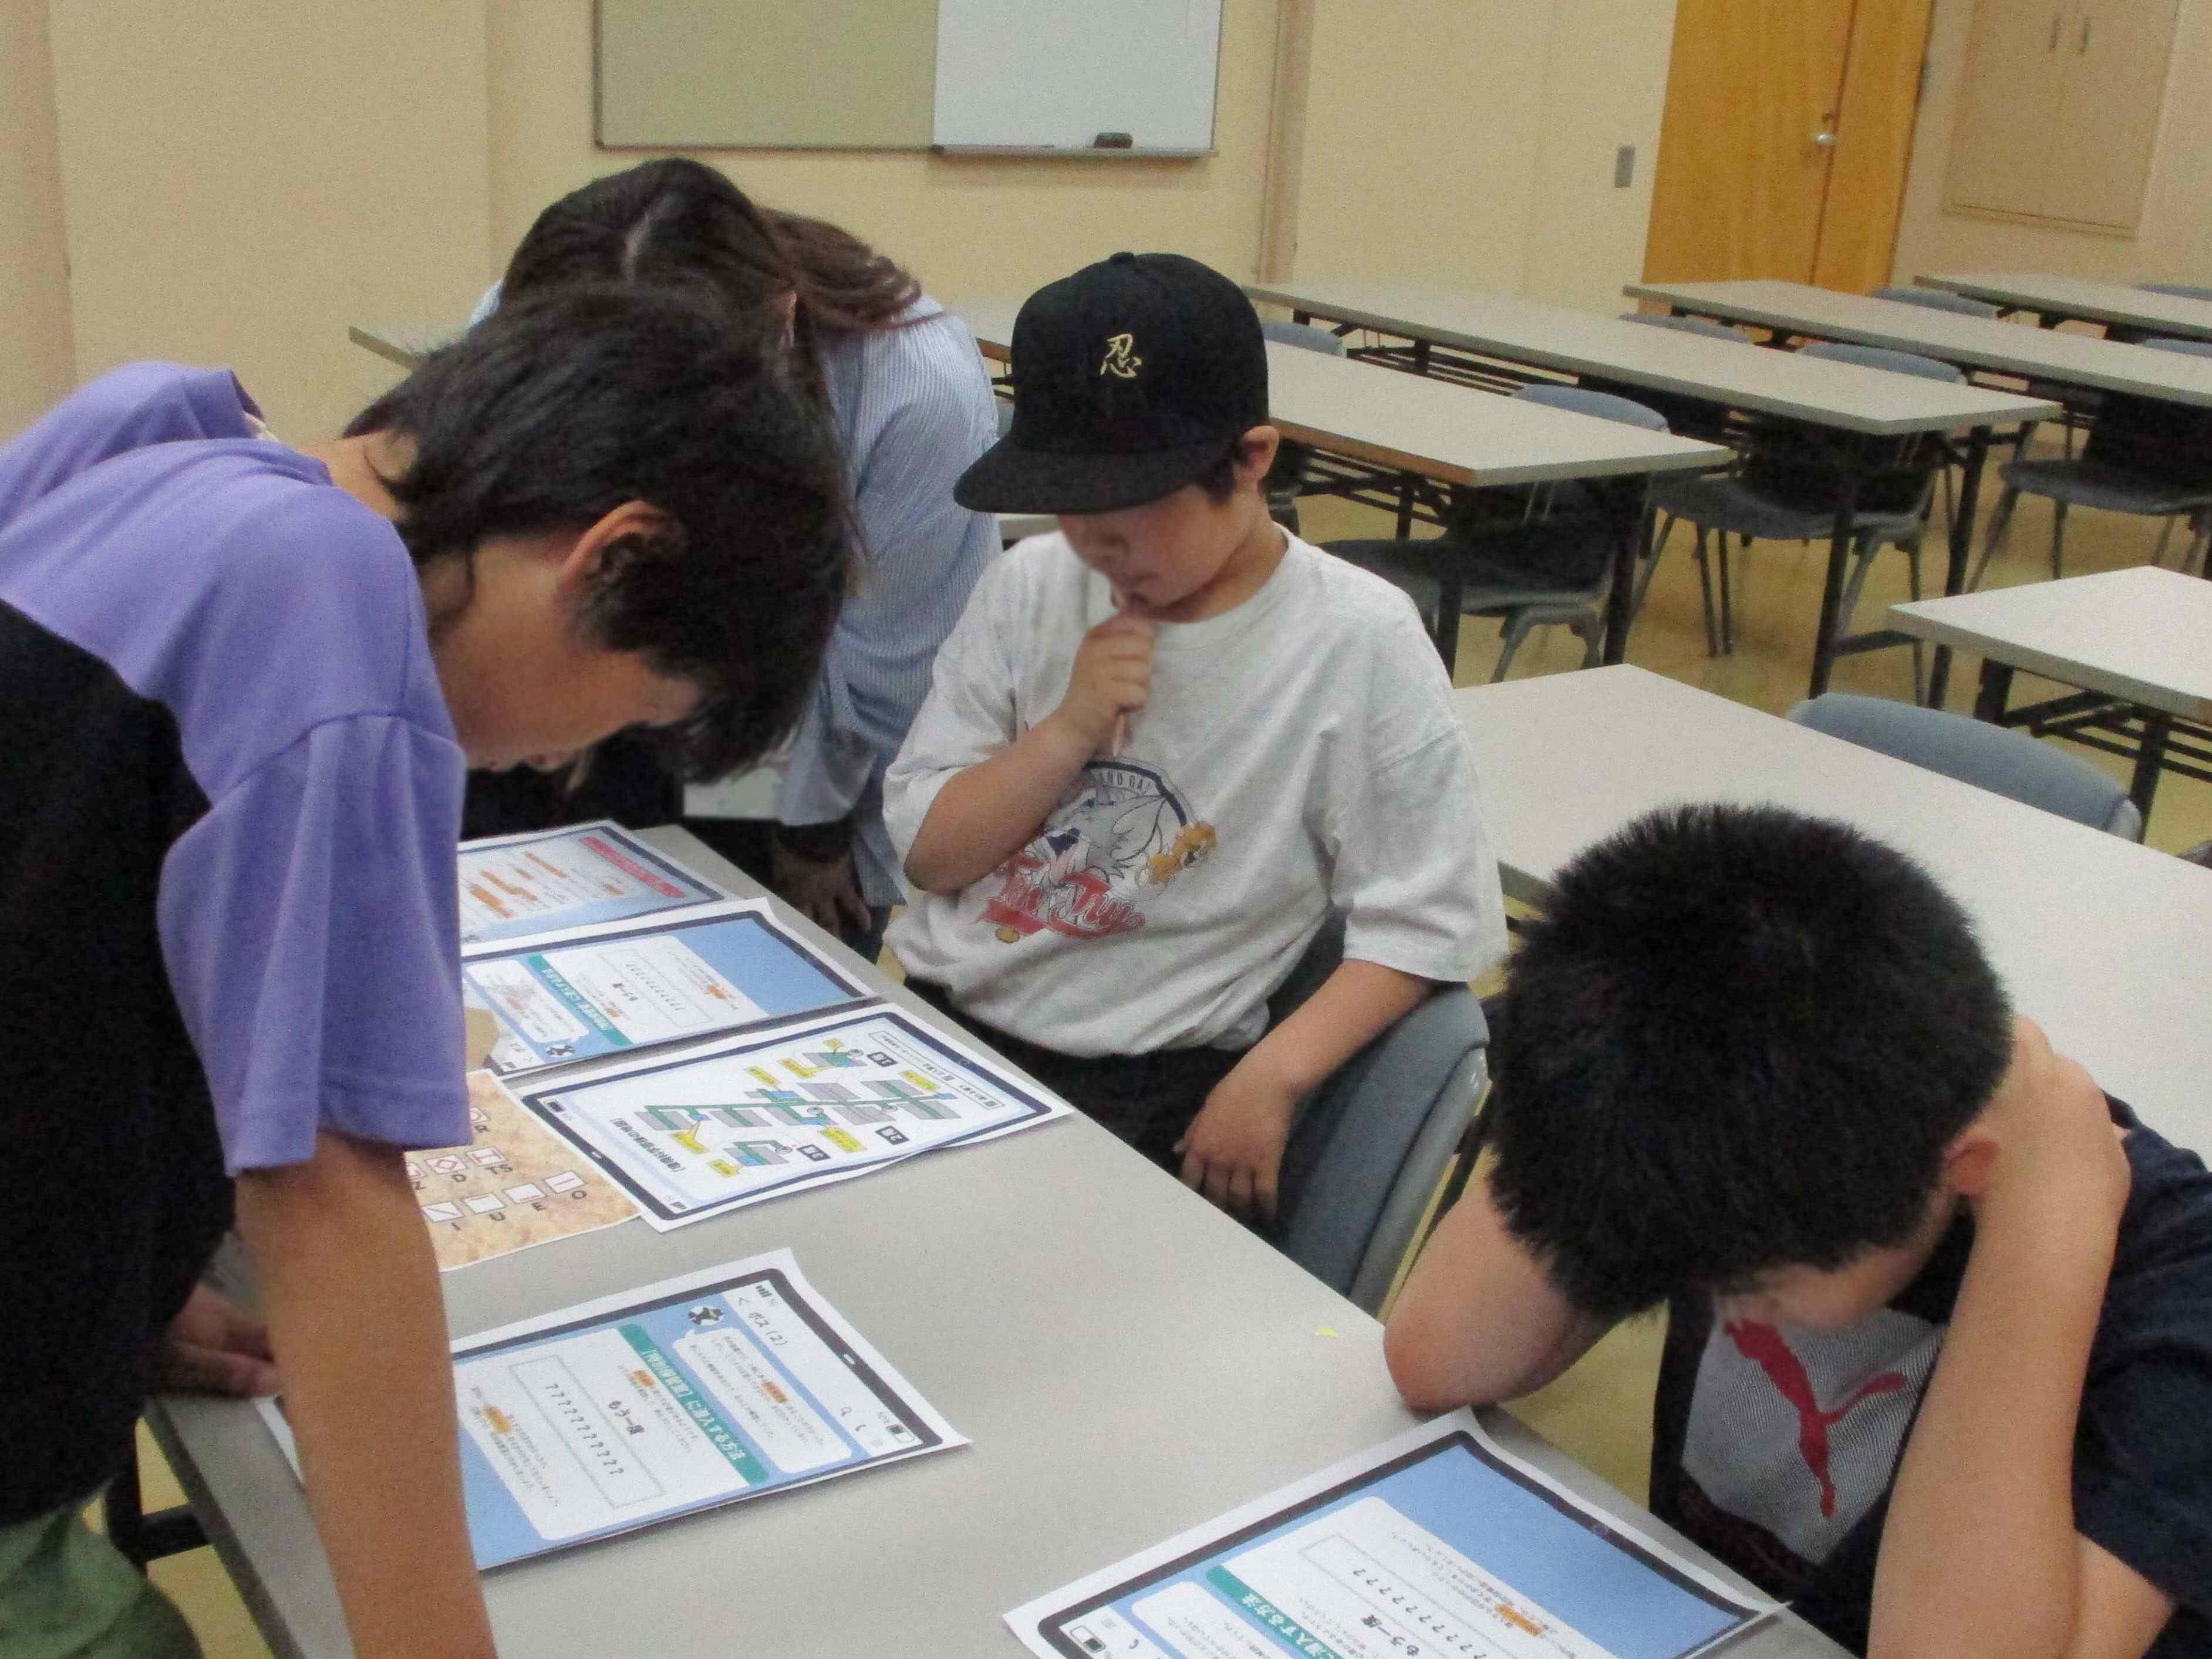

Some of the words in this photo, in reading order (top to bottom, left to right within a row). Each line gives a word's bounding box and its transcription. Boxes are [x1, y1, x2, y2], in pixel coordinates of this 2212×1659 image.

[1100, 333, 1142, 378] 忍
[608, 1400, 645, 1435] もう一度
[1360, 1614, 1420, 1657] もう一度
